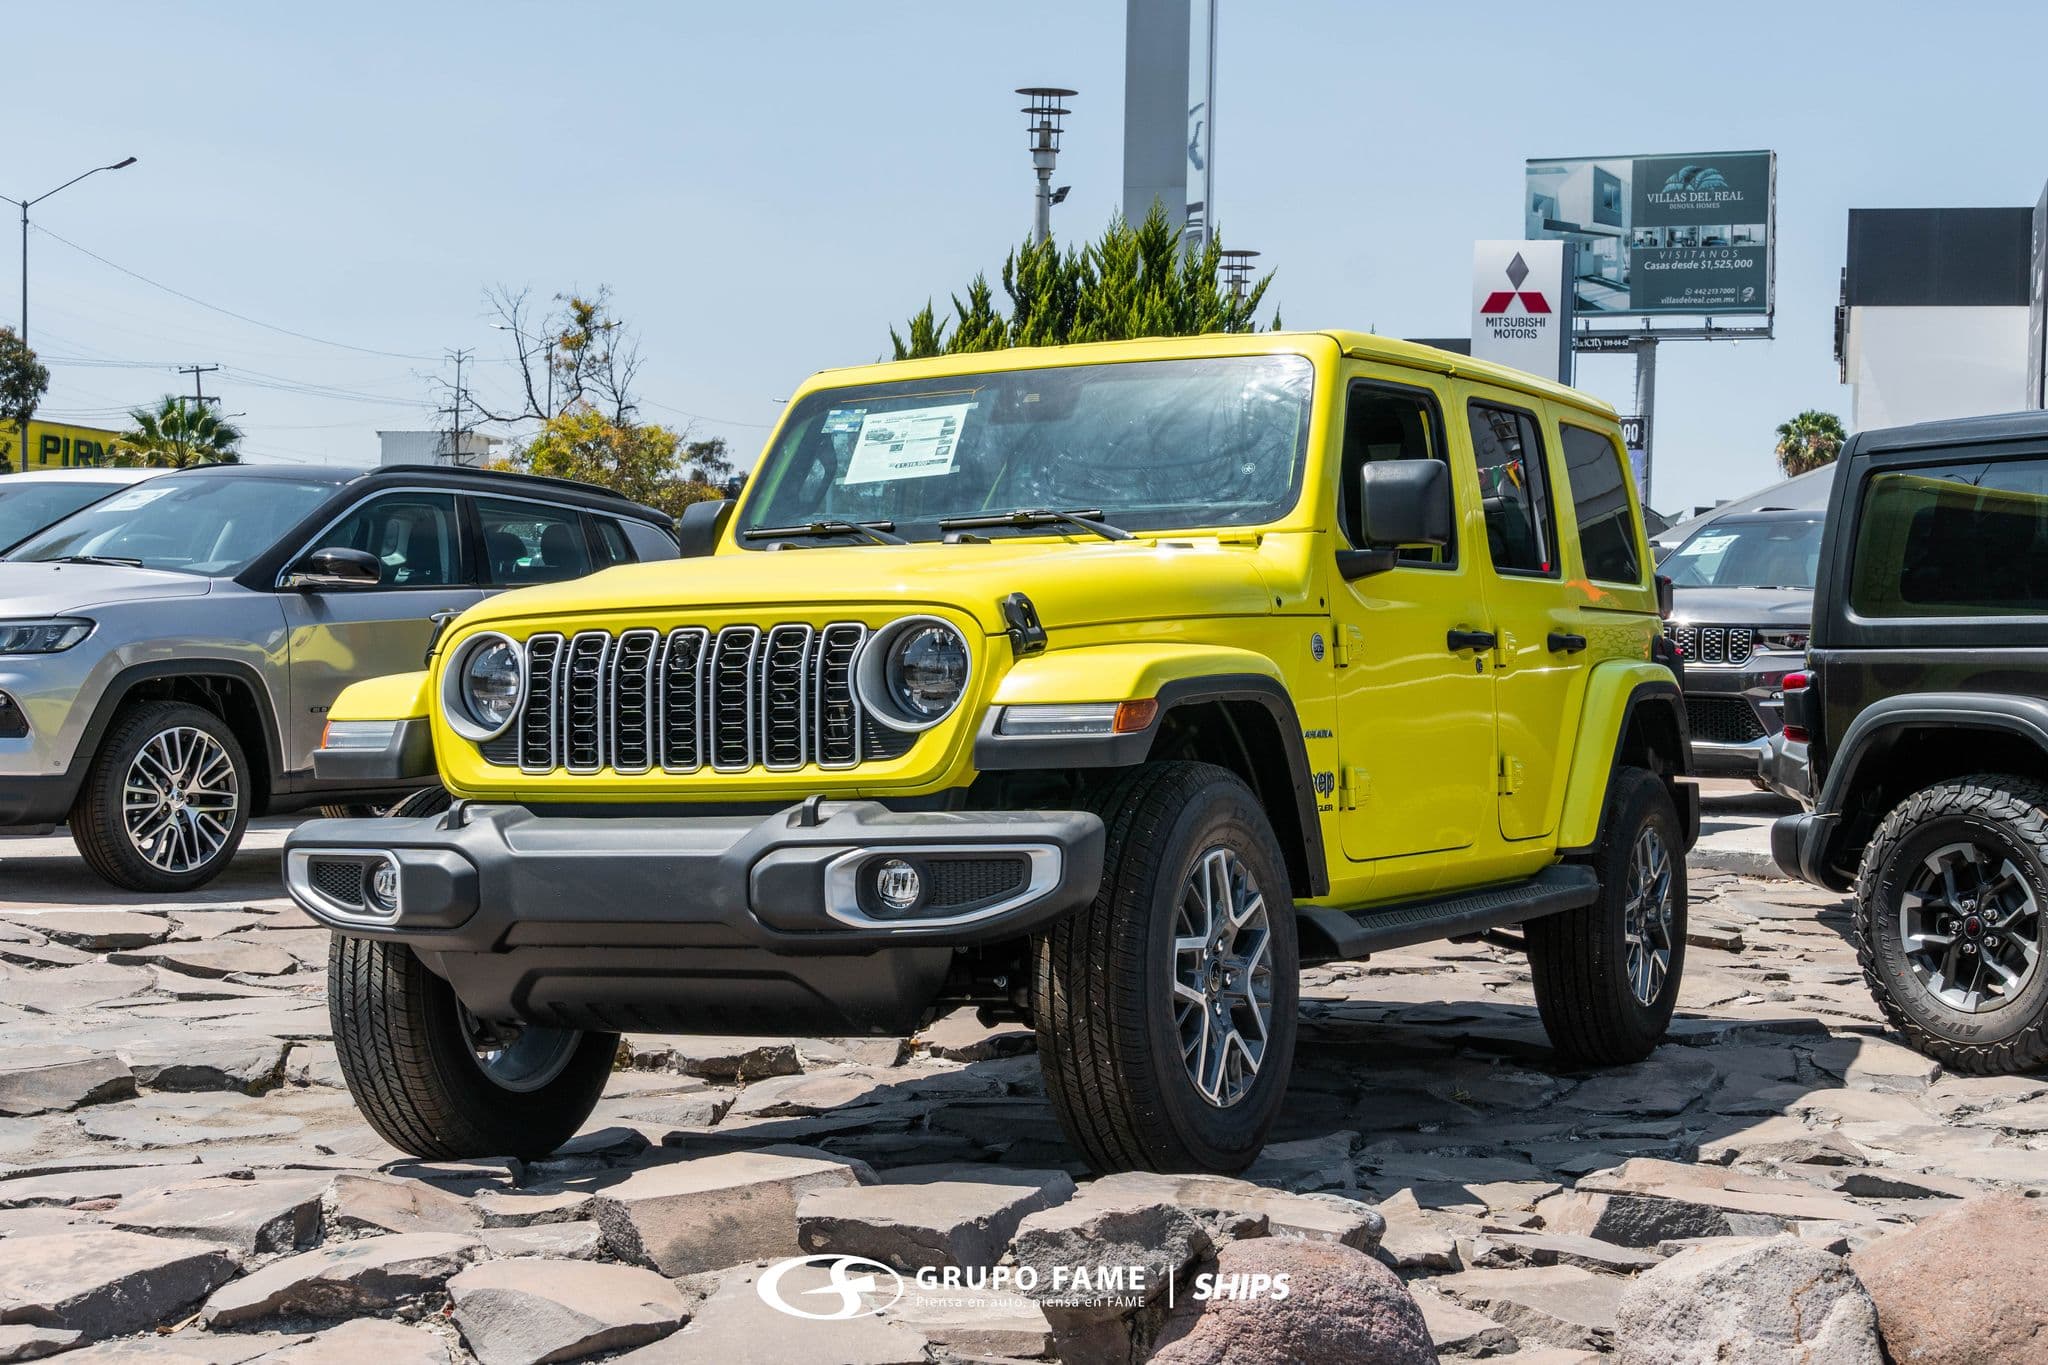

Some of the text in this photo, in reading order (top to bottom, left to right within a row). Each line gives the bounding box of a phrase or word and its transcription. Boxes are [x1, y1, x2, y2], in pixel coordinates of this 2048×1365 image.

[1647, 191, 1744, 203] VILLAS DEL REAL
[1644, 259, 1753, 270] Casas desde $1,525,000
[1485, 317, 1546, 327] MITSUBISHI
[1494, 329, 1538, 339] MOTORS
[1304, 730, 1333, 738] AHARA
[1313, 771, 1334, 798] ep
